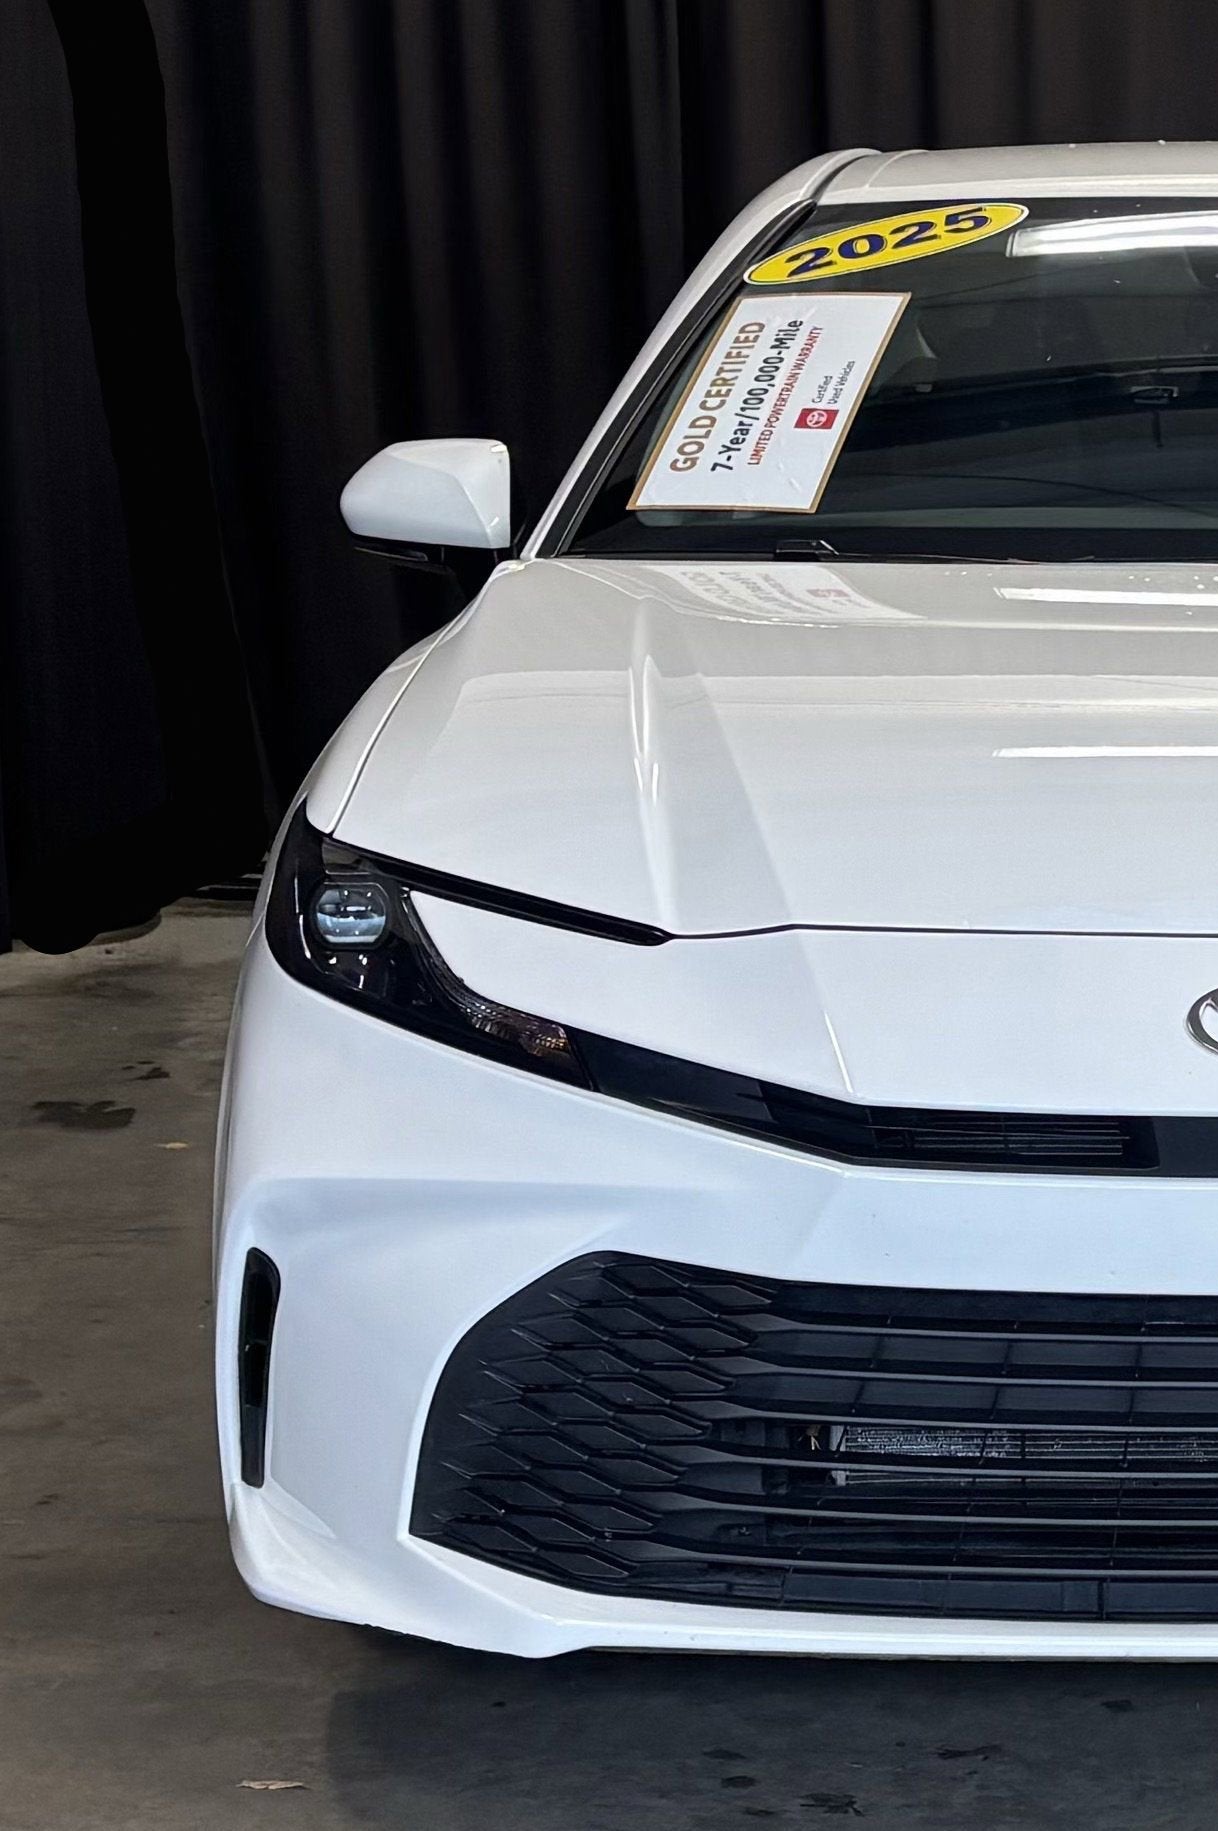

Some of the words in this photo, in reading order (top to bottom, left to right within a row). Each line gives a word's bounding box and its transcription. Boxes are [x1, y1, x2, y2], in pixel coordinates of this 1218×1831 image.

[785, 207, 992, 278] 2025
[670, 415, 717, 472] GOLD
[699, 321, 766, 411] CERTIFIED
[711, 320, 804, 472] 7-Year/100,000-Mile
[747, 429, 773, 465] LIMITED
[764, 372, 801, 428] POWERTRAIN
[790, 326, 823, 371] WARRANTY
[812, 375, 833, 404] Certified
[827, 387, 842, 405] Used
[835, 360, 855, 386] Vehicles
